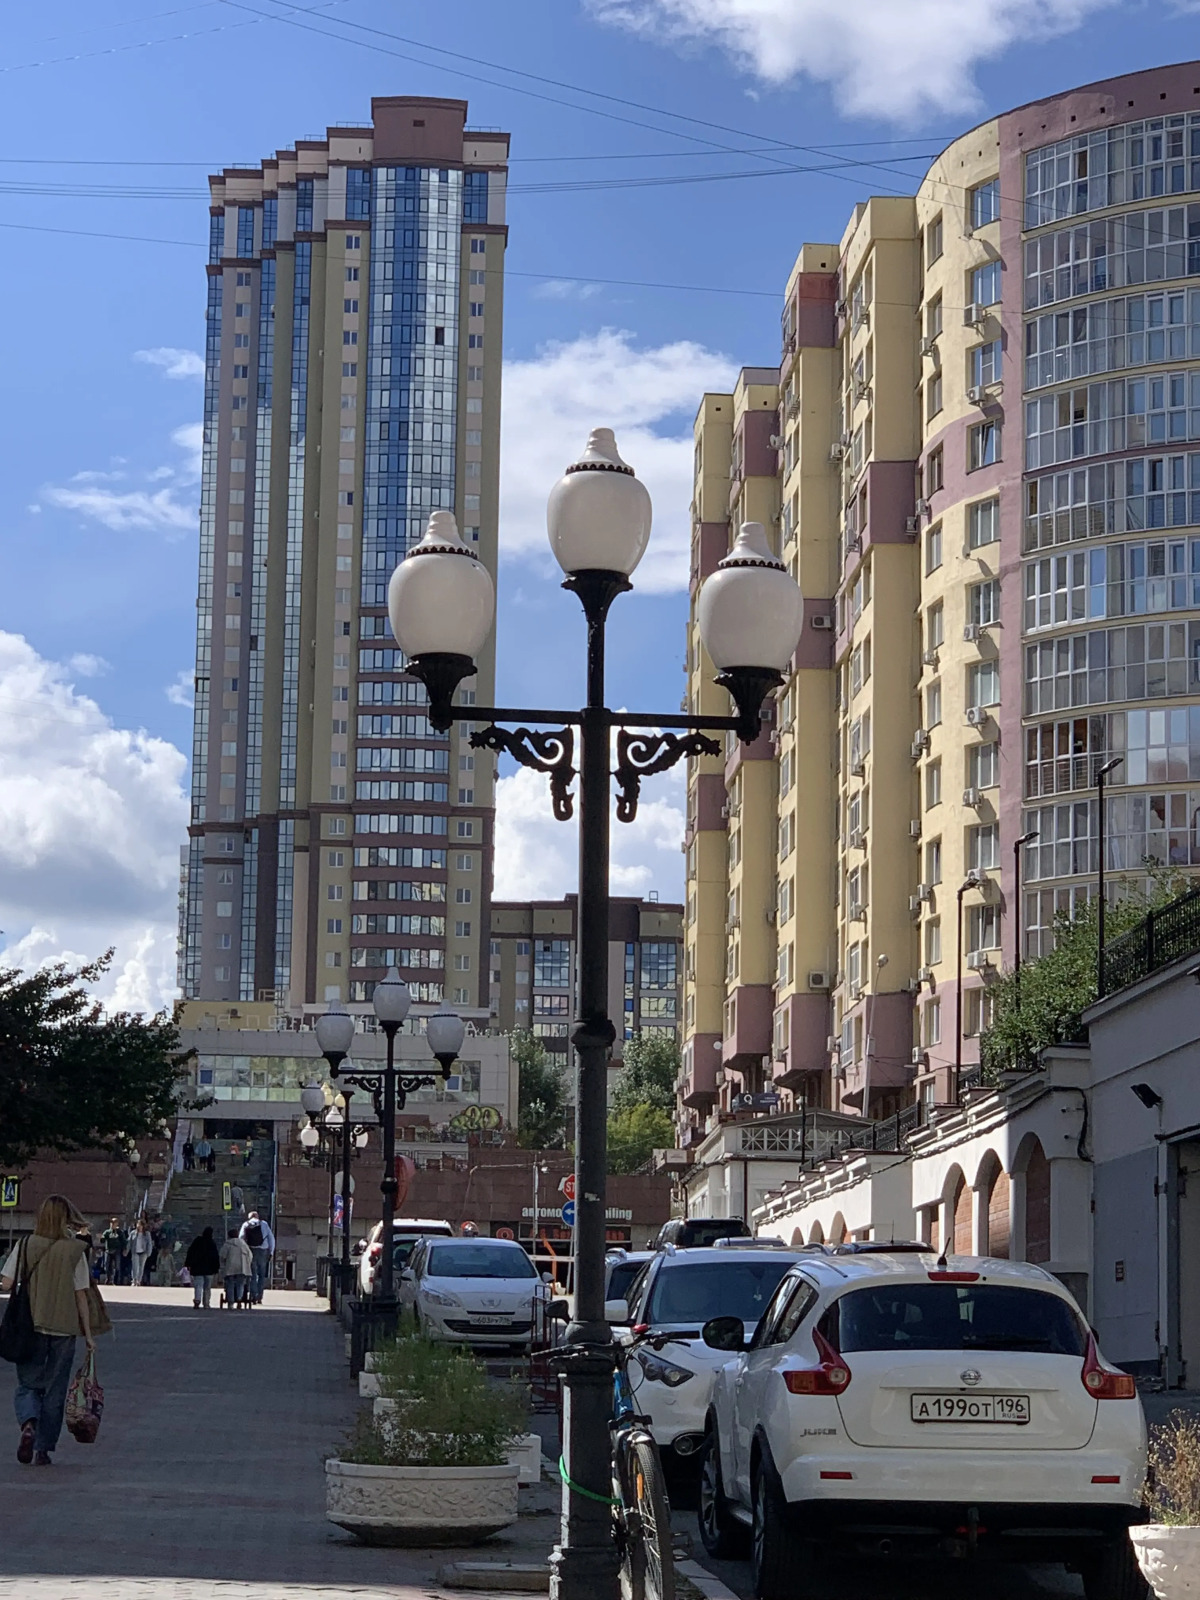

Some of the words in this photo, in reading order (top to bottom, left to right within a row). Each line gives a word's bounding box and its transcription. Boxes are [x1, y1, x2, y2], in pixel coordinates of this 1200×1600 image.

[522, 1207, 563, 1218] автомо
[605, 1207, 632, 1220] iling
[997, 1399, 1024, 1412] 196
